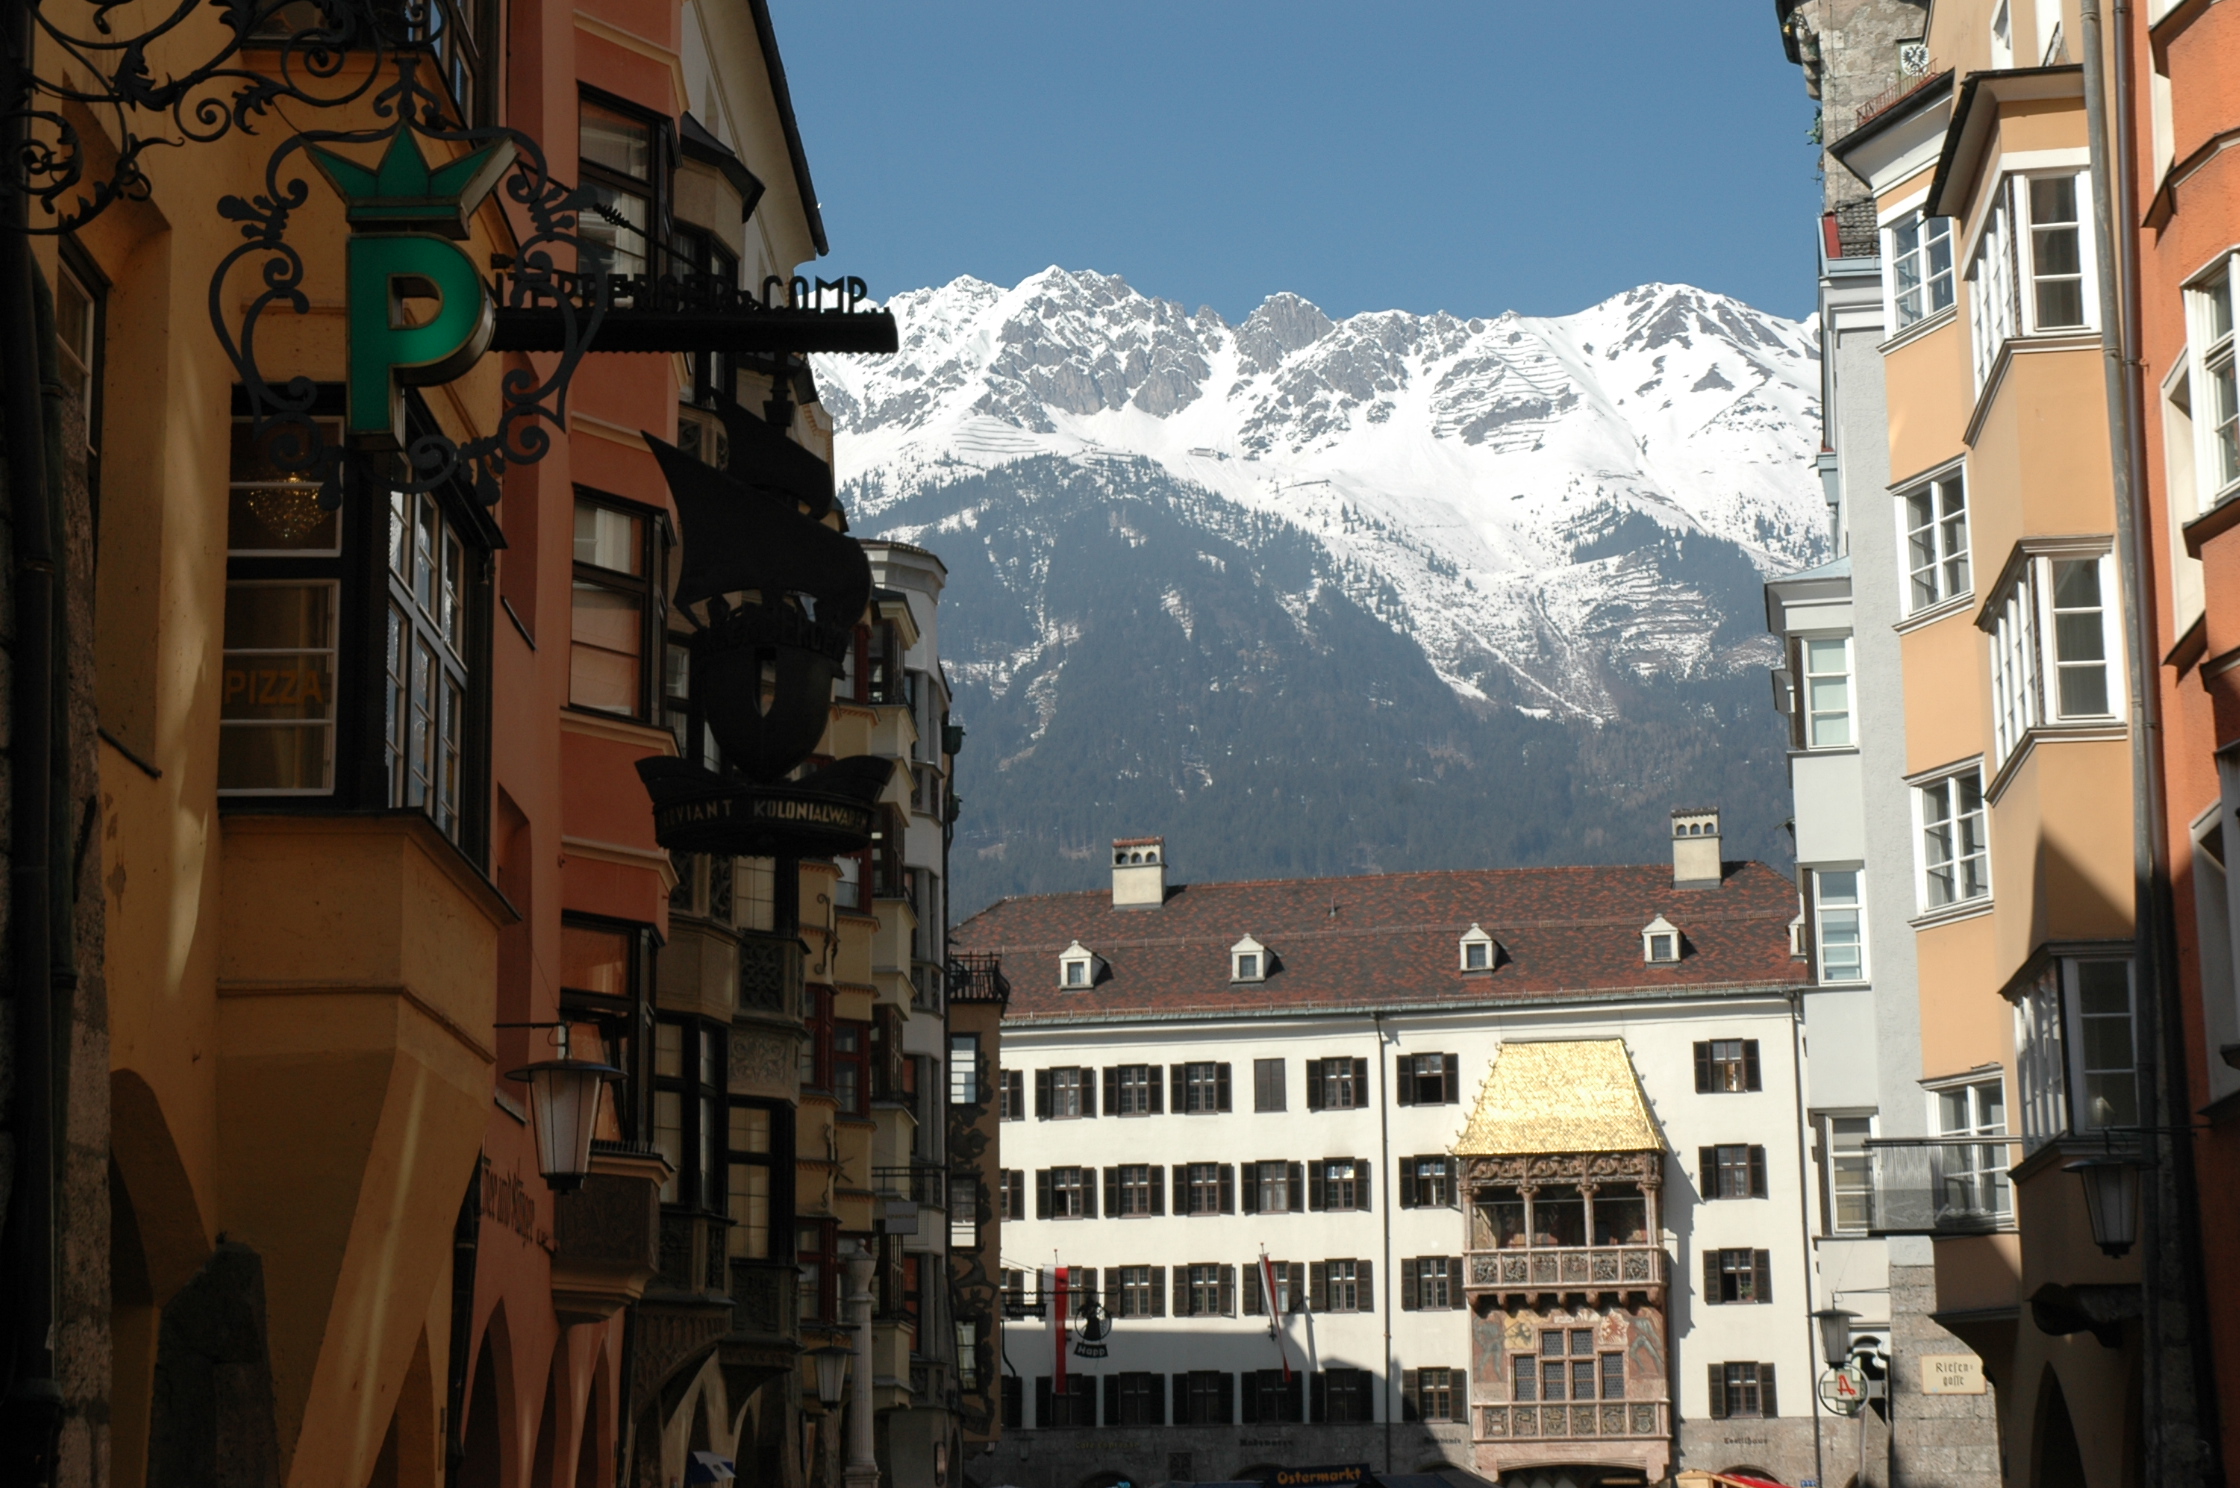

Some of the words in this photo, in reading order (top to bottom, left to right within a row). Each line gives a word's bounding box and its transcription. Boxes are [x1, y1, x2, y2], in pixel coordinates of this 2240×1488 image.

[346, 232, 492, 446] P
[225, 669, 323, 705] PIZZA
[1008, 1305, 1044, 1315] Weinhaus
[1077, 1344, 1105, 1357] Happ
[1277, 1466, 1362, 1485] Ostermarkt
